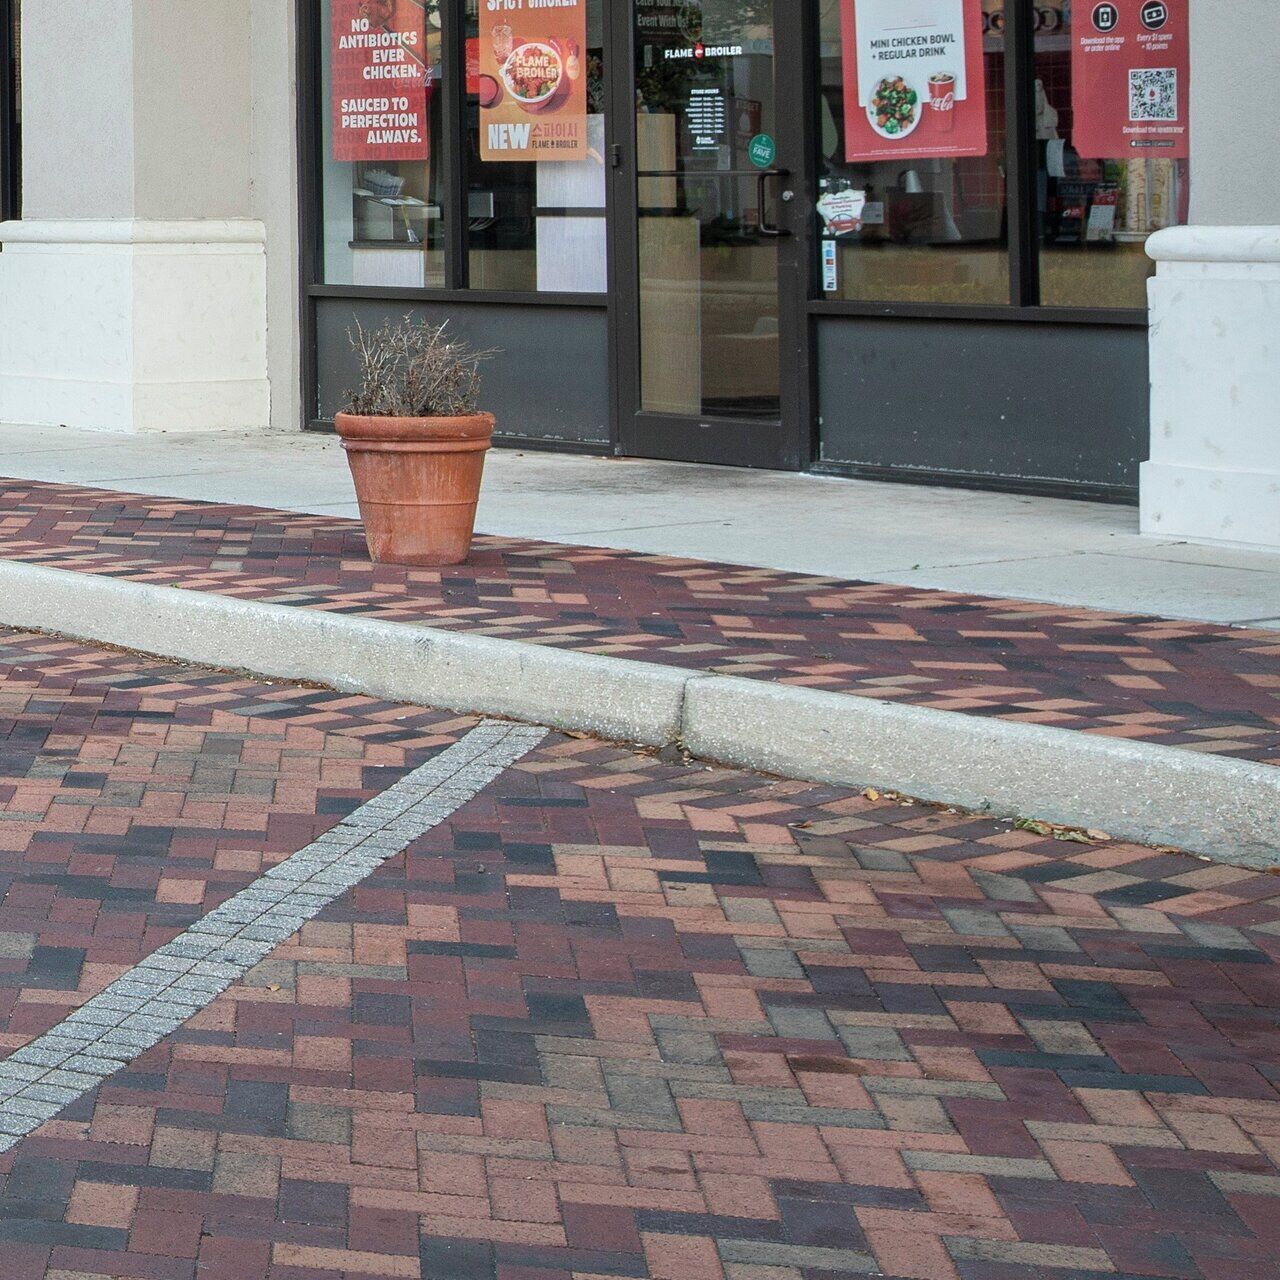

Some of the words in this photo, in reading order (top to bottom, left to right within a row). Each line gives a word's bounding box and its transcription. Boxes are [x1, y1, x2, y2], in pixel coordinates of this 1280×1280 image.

[351, 18, 369, 32] NO
[637, 14, 658, 27] Event
[339, 31, 418, 49] ANTIBIOTICS
[870, 39, 890, 49] MINI
[891, 36, 928, 47] CHICKEN
[929, 33, 955, 44] BOWL
[372, 49, 405, 63] EVER
[664, 48, 693, 59] FLAME
[704, 46, 742, 57] BROILER
[878, 49, 917, 60] REGULAR
[919, 47, 946, 58] DRINK
[516, 56, 550, 67] FLAME
[363, 65, 420, 80] CHICKEN.
[516, 66, 558, 78] BROILER
[341, 97, 389, 112] SAUCED
[392, 97, 409, 111] TO
[341, 113, 418, 129] PERFECTION
[367, 129, 422, 144] ALWAYS.
[488, 123, 531, 150] NEW
[531, 123, 579, 138] 스파이시
[532, 140, 550, 149] FLAME
[555, 139, 578, 149] BROILER
[752, 147, 771, 159] FAVE
